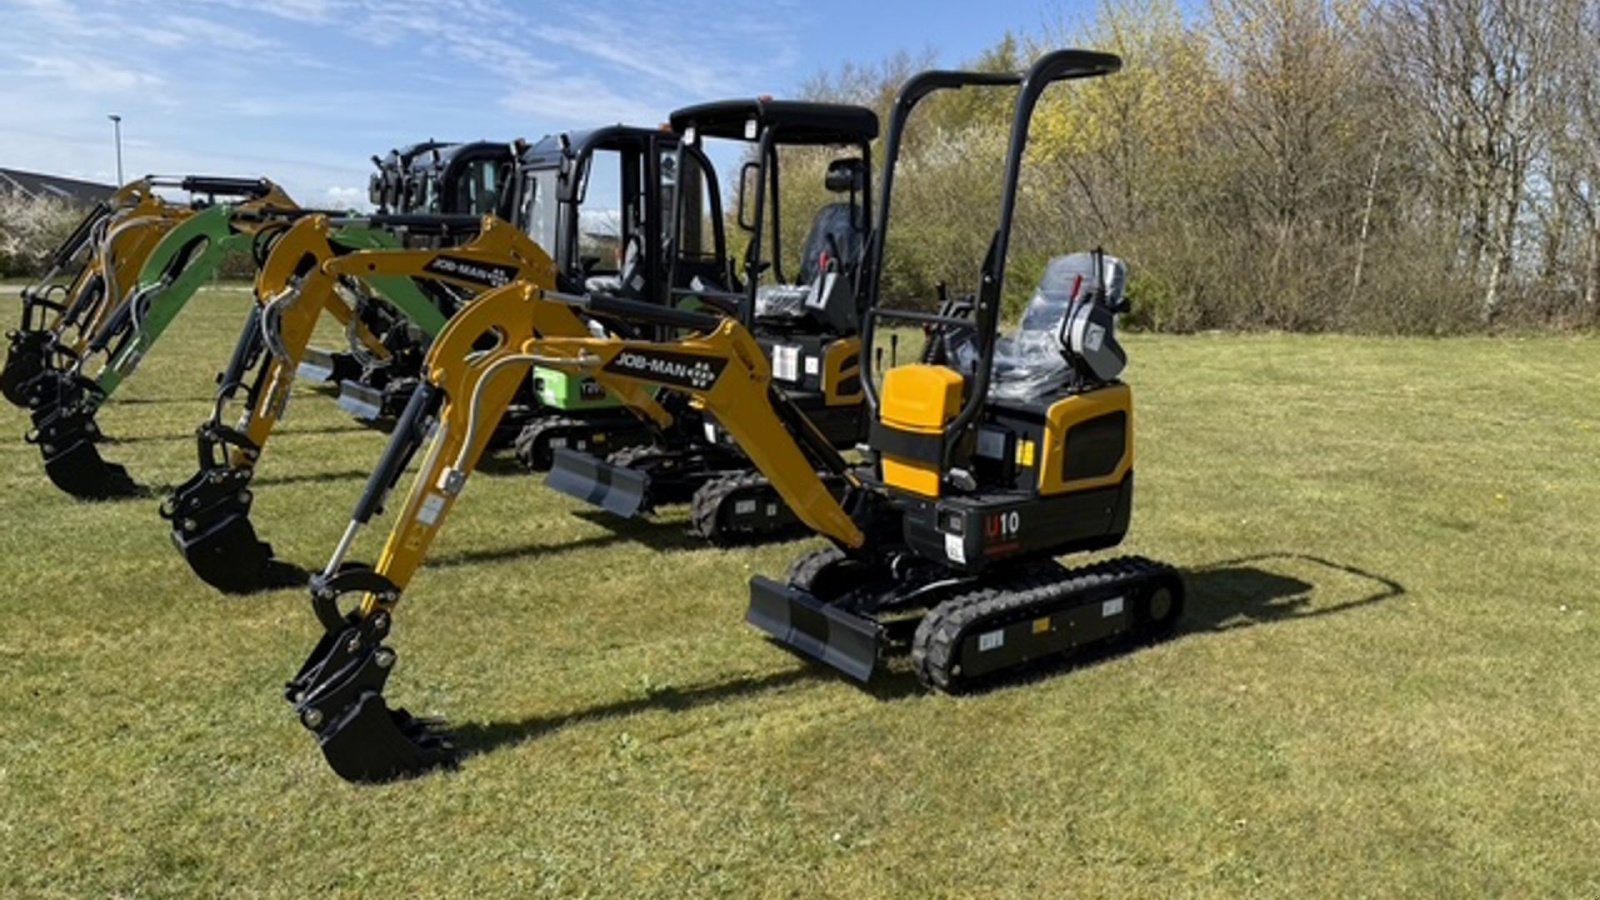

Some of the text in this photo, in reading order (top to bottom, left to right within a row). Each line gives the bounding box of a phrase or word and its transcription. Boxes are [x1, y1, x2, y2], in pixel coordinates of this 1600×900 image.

[432, 259, 486, 279] JOB-MAN
[616, 352, 686, 377] JOB-MAN
[986, 510, 1020, 537] U10
